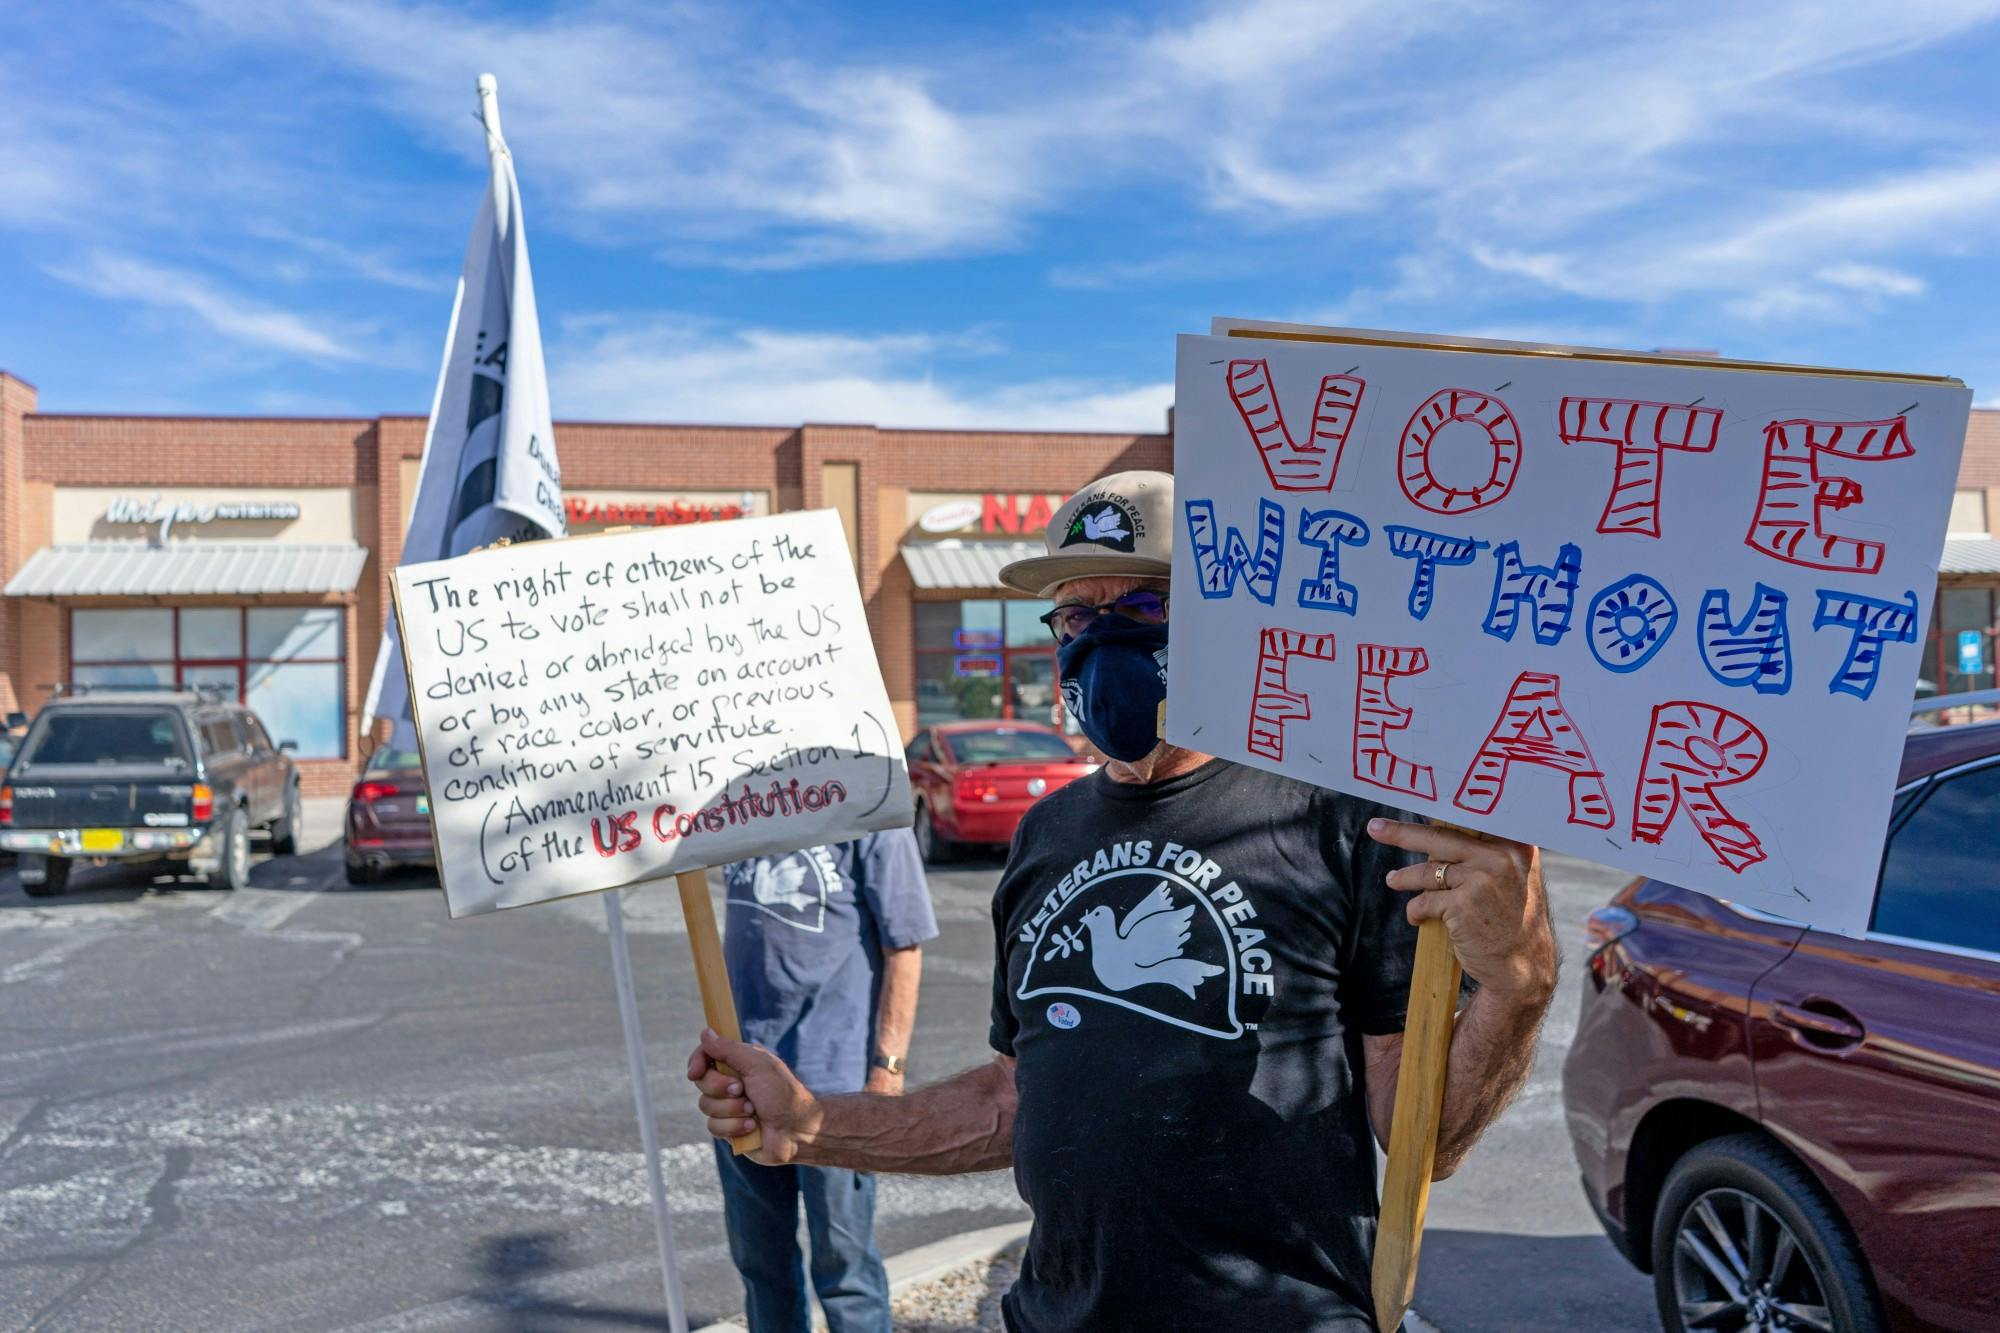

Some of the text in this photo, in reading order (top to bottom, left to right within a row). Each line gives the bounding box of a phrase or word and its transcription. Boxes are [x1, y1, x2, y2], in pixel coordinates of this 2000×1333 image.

[1226, 358, 1916, 574] VOTE
[982, 493, 1072, 534] NA
[1064, 491, 1146, 539] VETERANS FOR PEACE
[412, 534, 816, 613] The right of citizens of the
[436, 573, 797, 657] US to vote shall not be
[1184, 497, 1918, 702] WITHOUT
[426, 603, 842, 700] denied or abridged by the US
[439, 643, 844, 732] or by any state on account
[449, 735, 484, 767] of
[672, 699, 700, 721] or
[711, 680, 835, 724] previous
[732, 742, 840, 778] Section
[1246, 626, 1769, 875] FEAR
[444, 758, 577, 802] condition
[589, 742, 621, 770] of
[499, 777, 848, 873] of the US Constitution
[1018, 839, 1275, 998] VETERANS FOR PEACE
[1245, 1022, 1258, 1031] TM
